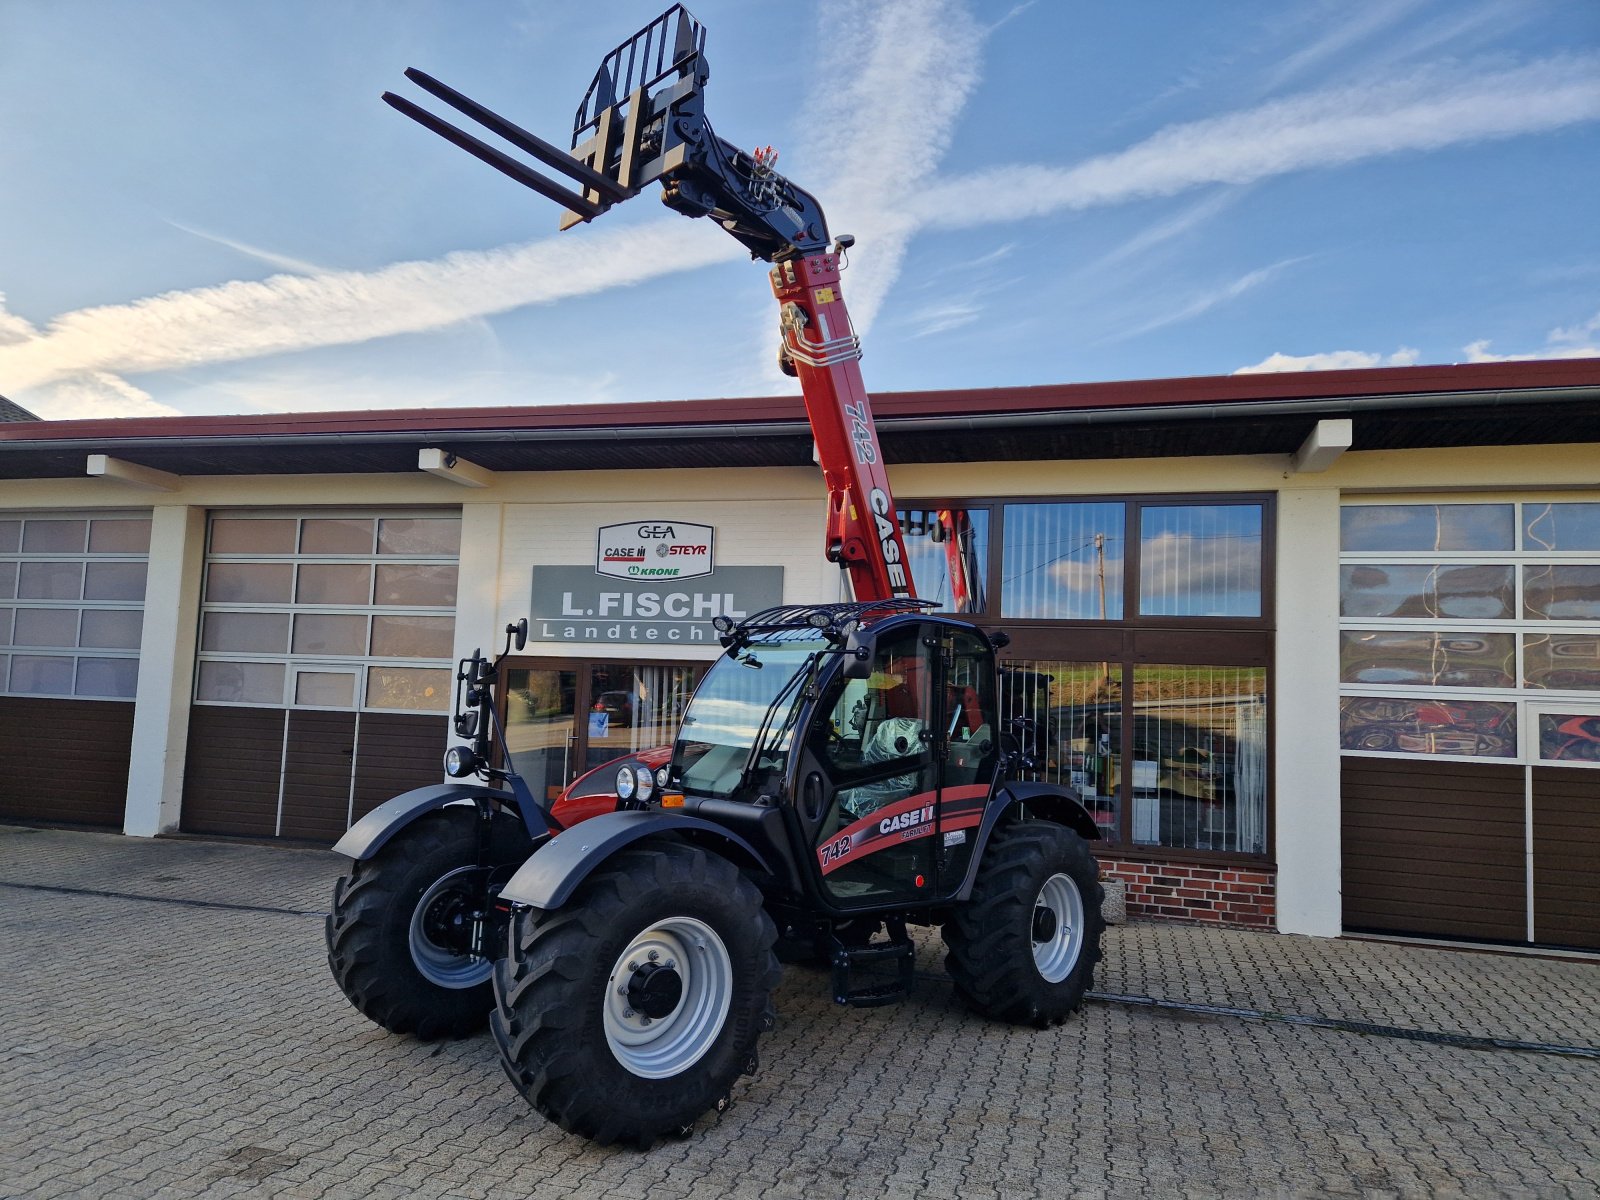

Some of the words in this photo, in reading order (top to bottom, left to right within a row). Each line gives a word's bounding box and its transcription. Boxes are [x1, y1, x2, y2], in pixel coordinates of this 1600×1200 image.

[845, 400, 876, 465] 742
[638, 526, 676, 539] GEA
[869, 488, 907, 587] CASE
[604, 548, 635, 557] CASE
[669, 545, 707, 555] STEYR
[640, 568, 680, 576] KRONE
[562, 592, 747, 618] L.FISCHL
[879, 809, 920, 834] CASE
[821, 834, 851, 867] 742
